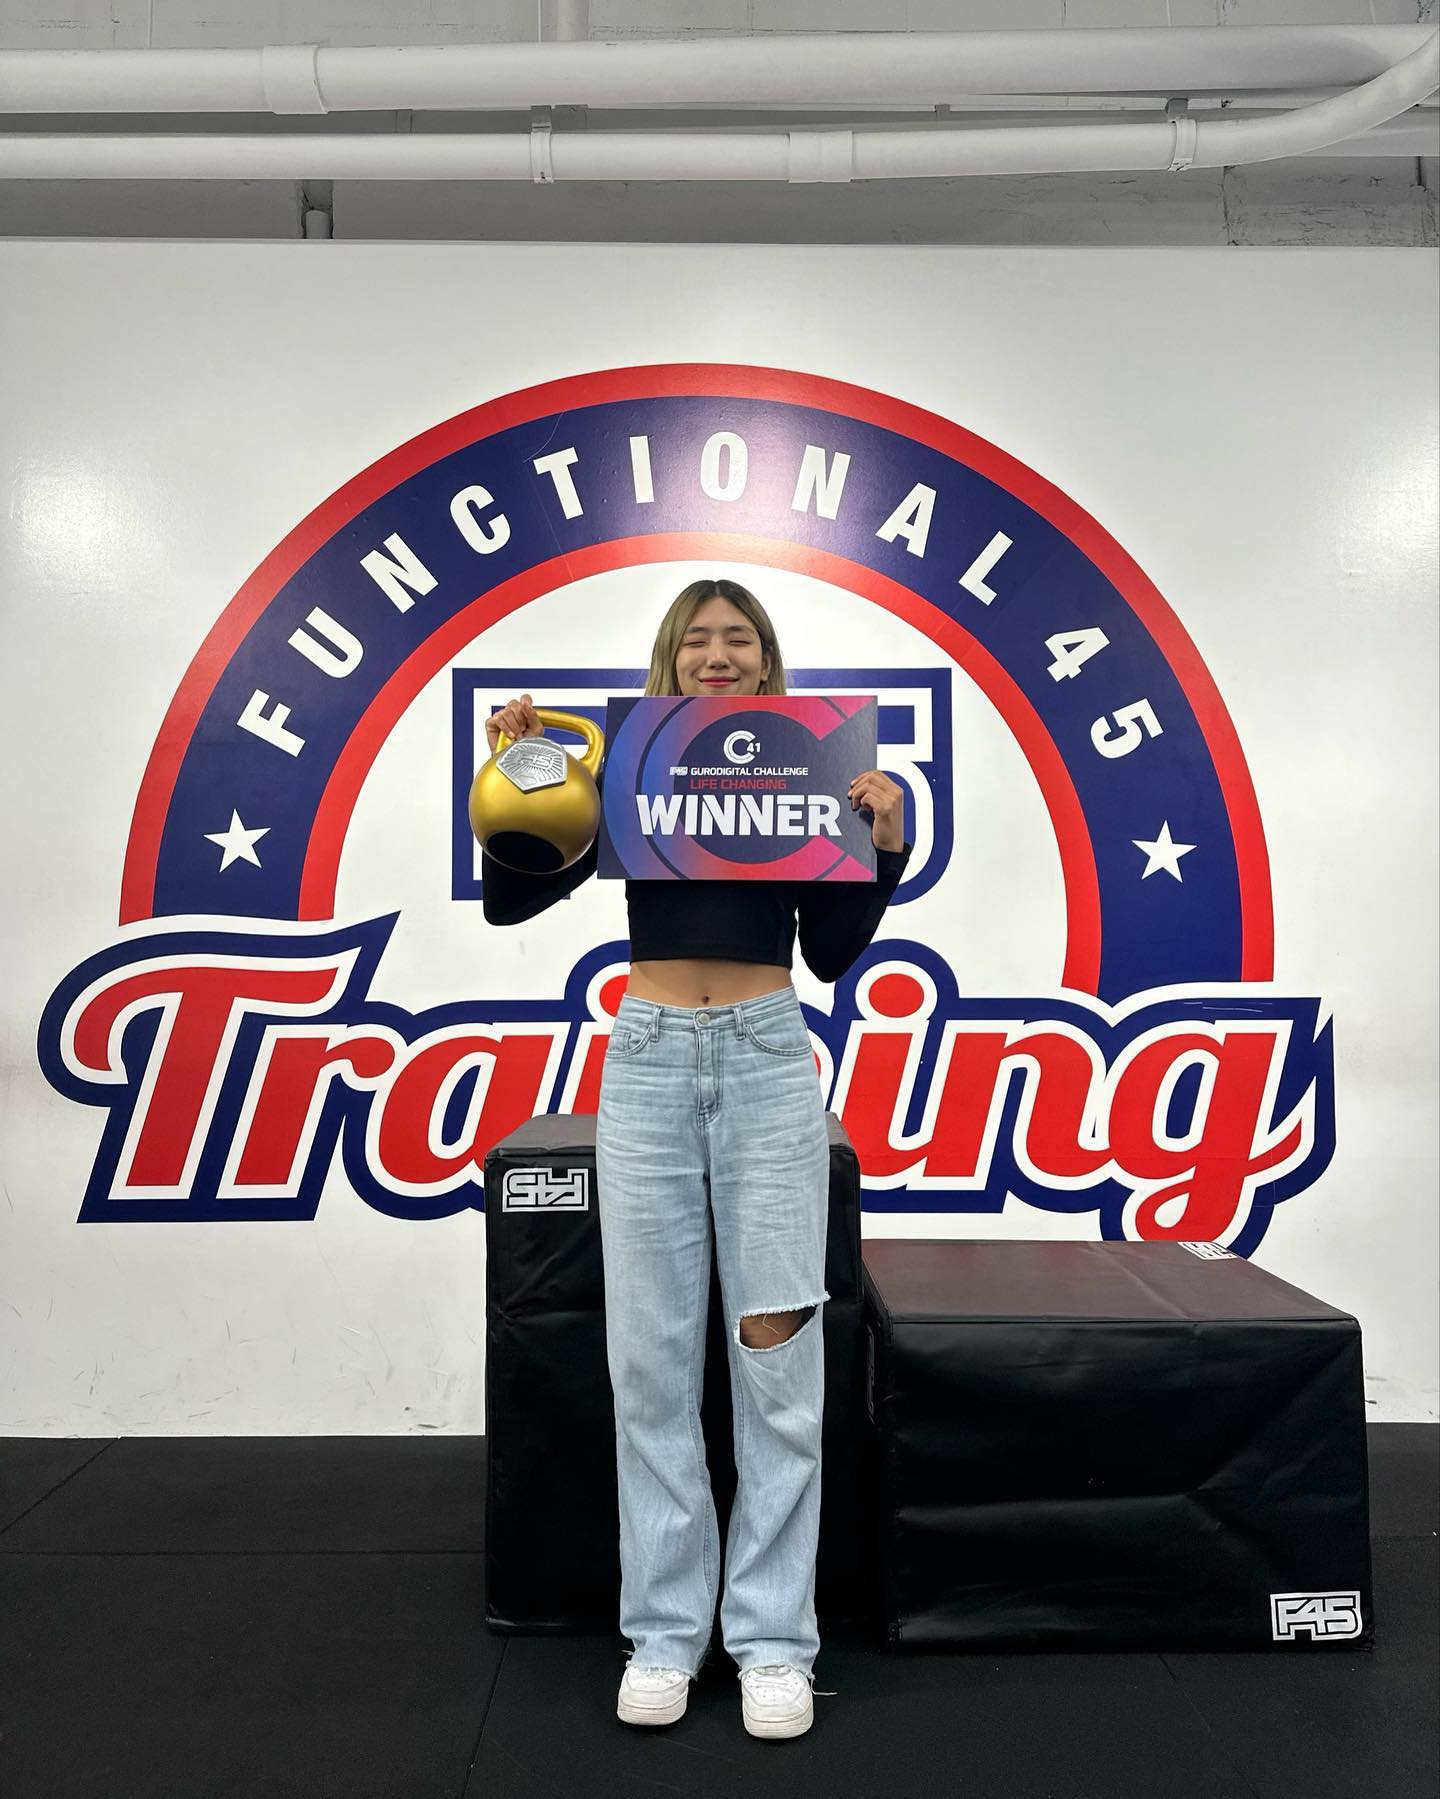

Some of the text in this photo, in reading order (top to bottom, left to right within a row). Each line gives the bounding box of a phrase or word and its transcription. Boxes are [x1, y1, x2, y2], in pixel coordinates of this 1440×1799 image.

[236, 431, 1164, 759] FUNCTIONAL 45
[690, 767, 752, 776] GURODIGITAL
[753, 767, 809, 776] CHALLENGE
[690, 779, 787, 790] LIFE CHANGING
[635, 794, 842, 836] WINNER
[62, 948, 1314, 1243] Traing
[503, 1168, 588, 1212] F45
[1270, 1591, 1362, 1640] F45
